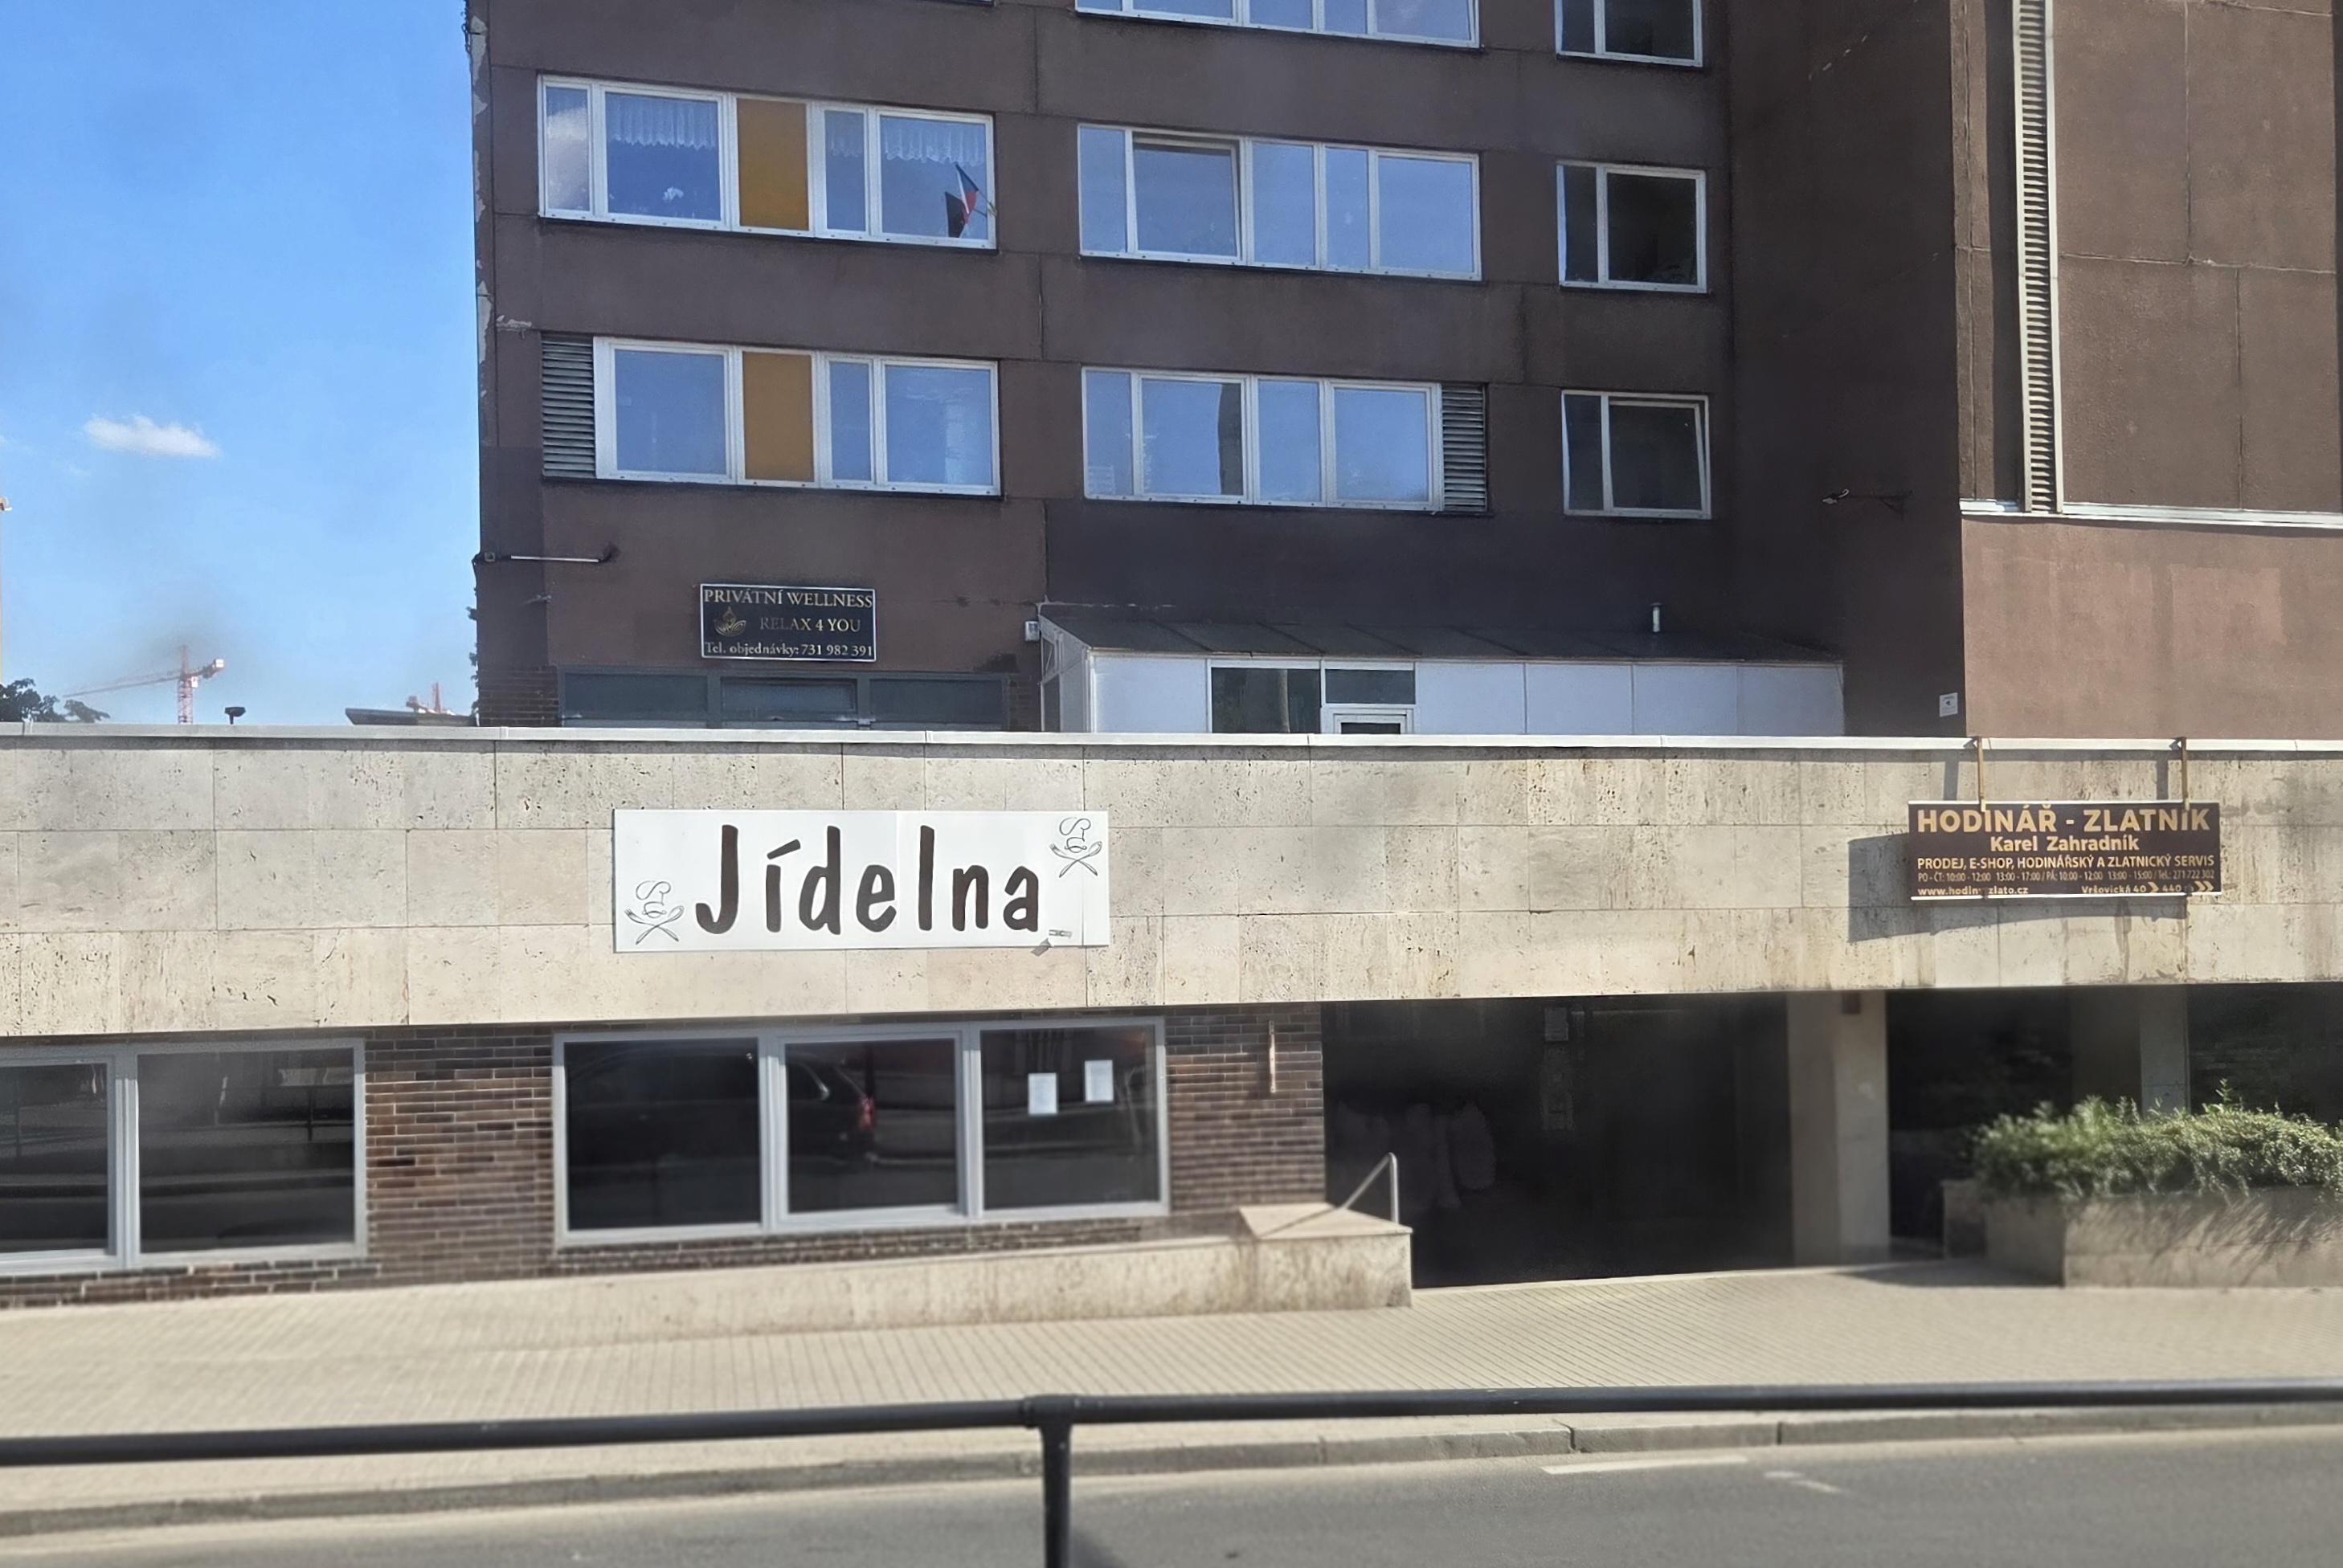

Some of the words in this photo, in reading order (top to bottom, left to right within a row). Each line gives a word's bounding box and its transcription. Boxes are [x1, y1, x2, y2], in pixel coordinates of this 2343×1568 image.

[704, 588, 783, 605] PRIVÁTNÍ
[787, 592, 873, 608] WELLNESS
[760, 617, 811, 631] RELAX
[816, 619, 824, 631] 4
[828, 619, 861, 633] YOU
[705, 642, 726, 654] Tel.
[730, 642, 799, 657] objednávky:
[802, 644, 822, 655] 731
[826, 644, 848, 655] 982
[851, 645, 873, 656] 391
[1917, 803, 2057, 833] HODINÁŘ
[1990, 835, 2038, 851] Karel
[2047, 833, 2140, 851] Zahradník
[1917, 857, 1966, 871] PRODEJ,
[1969, 857, 2014, 871] E-SHOP,
[2017, 854, 2094, 869] HODINÁŘSKÝ
[2096, 857, 2105, 868] A
[2108, 854, 2171, 868] ZLATNICKÝ
[2174, 855, 2214, 867] SERVIS
[695, 824, 1040, 936] Jídelna
[1918, 872, 1928, 882] PO
[1972, 872, 1991, 881] 12:00
[1996, 872, 2015, 881] 13:00
[2084, 871, 2104, 880] 12:00
[2133, 884, 2147, 893] 40
